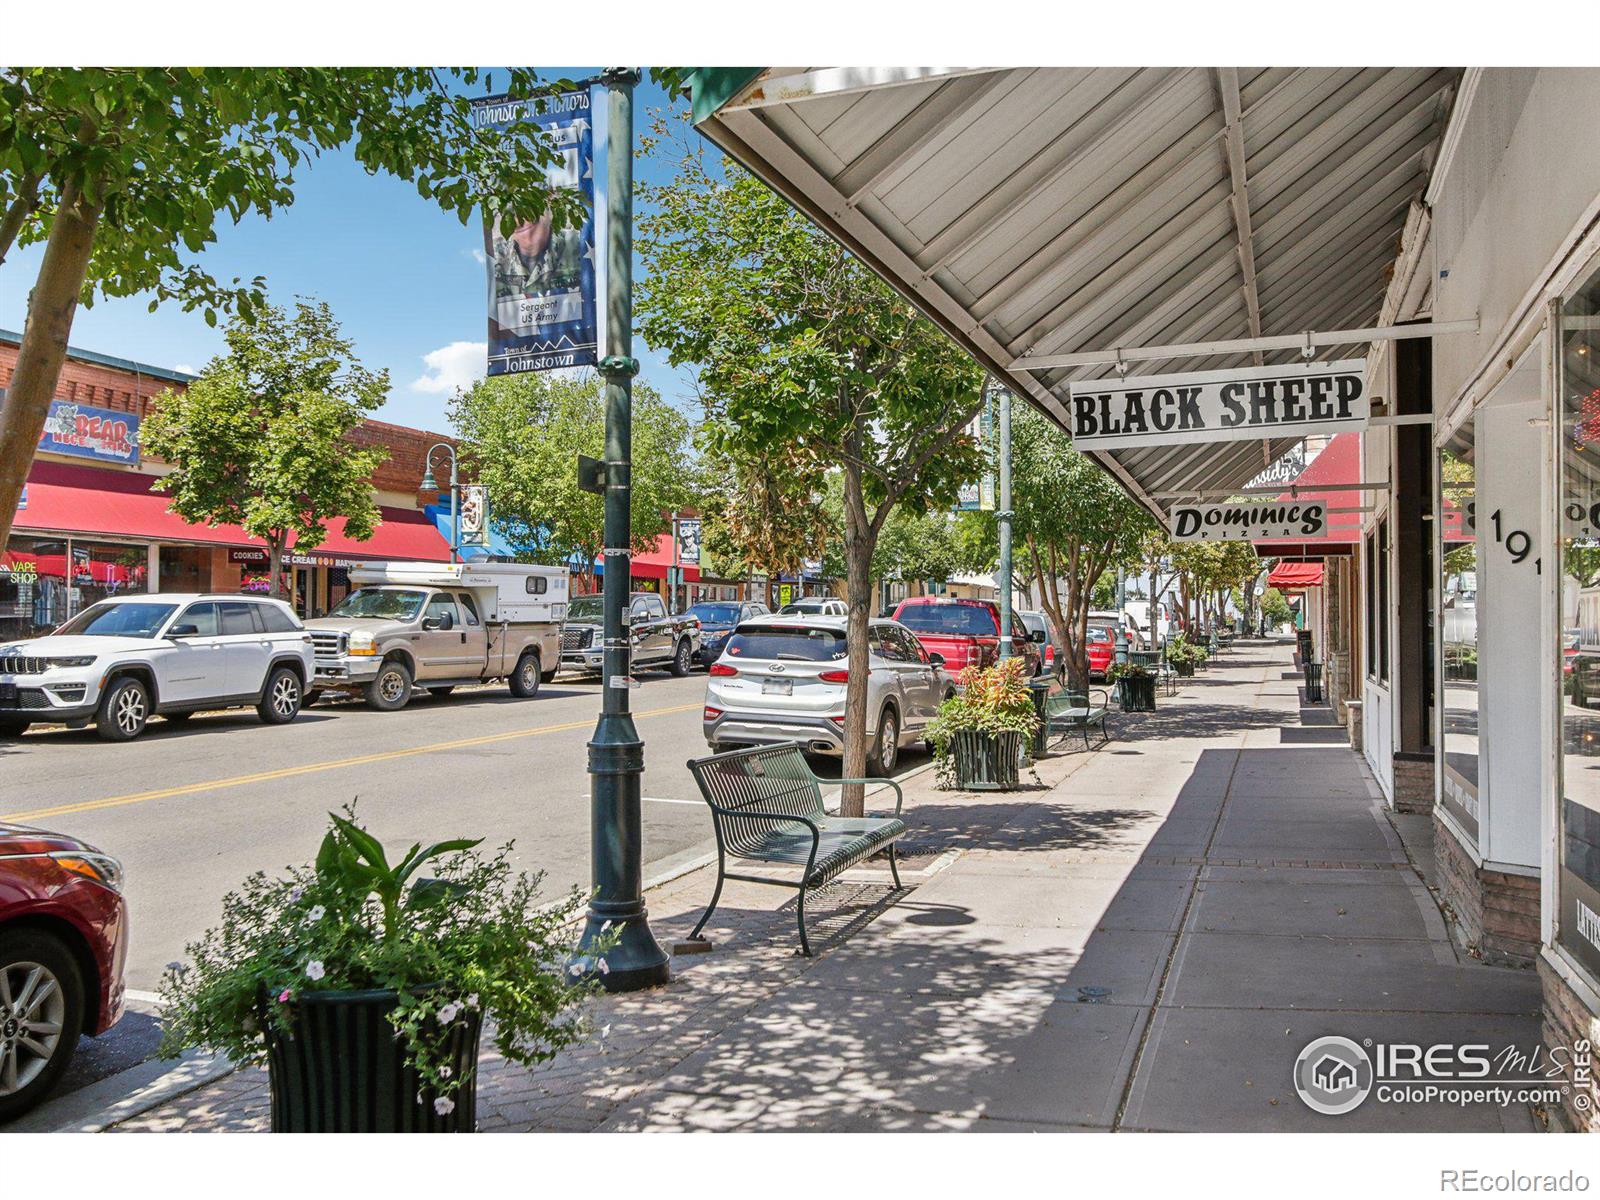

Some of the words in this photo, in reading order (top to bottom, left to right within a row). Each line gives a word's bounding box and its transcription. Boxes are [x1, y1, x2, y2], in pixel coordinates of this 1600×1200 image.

[487, 98, 502, 106] Town
[520, 300, 559, 313] Sergeant
[521, 315, 533, 324] US
[535, 312, 559, 322] Army
[503, 347, 520, 356] Town
[520, 344, 528, 353] of
[503, 354, 575, 373] Johnstown
[1073, 387, 1205, 437] BLACK
[1219, 375, 1363, 427] SHEEP
[75, 414, 130, 446] BEAR
[1201, 527, 1291, 539] PIZZA
[233, 551, 264, 560] COOKIES
[281, 555, 291, 564] CE
[291, 556, 317, 565] CREAM
[11, 561, 37, 573] VAPE
[10, 572, 38, 584] SHOP
[249, 581, 270, 591] OPEN
